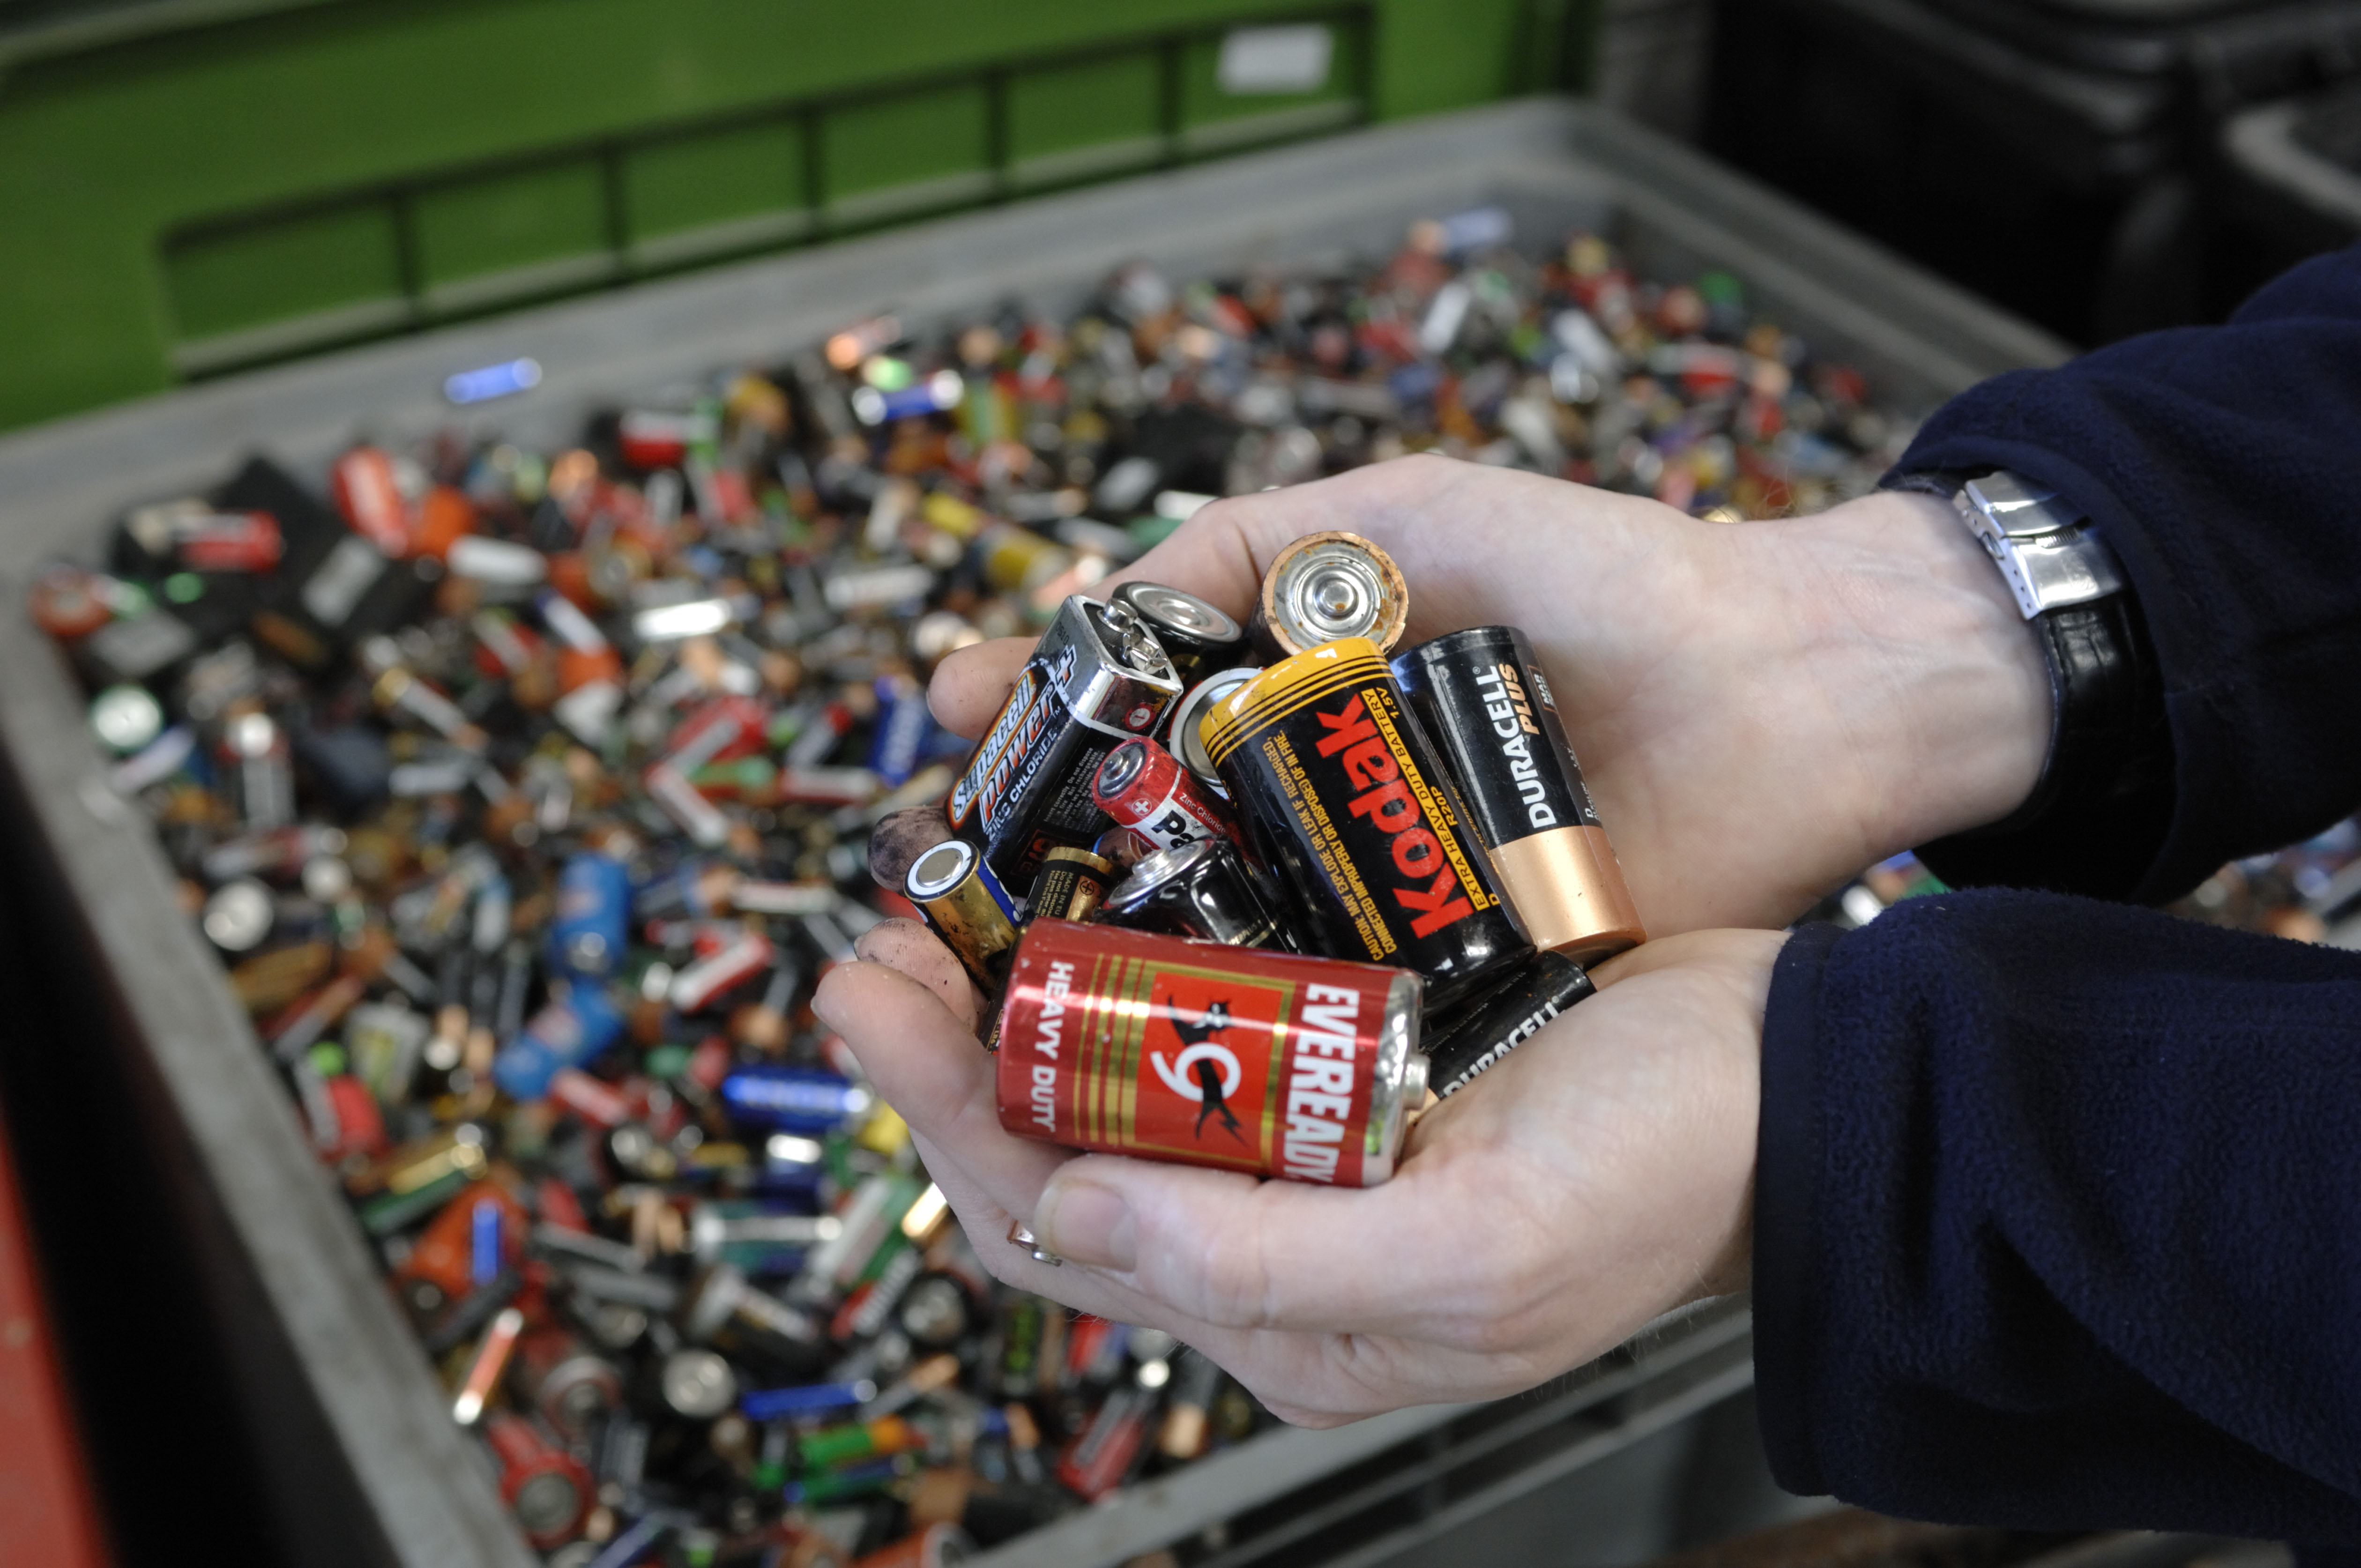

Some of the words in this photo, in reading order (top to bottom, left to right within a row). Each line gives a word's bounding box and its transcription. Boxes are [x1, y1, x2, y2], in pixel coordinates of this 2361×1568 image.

[1376, 686, 1400, 719] 1.5V
[1499, 663, 1540, 735] PLUS
[1274, 730, 1293, 757] FIRE.
[1364, 691, 1409, 758] BATTERY
[953, 674, 1031, 820] Supacell
[1079, 747, 1094, 767] dispose
[1285, 753, 1299, 767] IN
[1476, 665, 1557, 829] DURACELL
[986, 802, 1011, 842] ZINC
[1009, 728, 1058, 803] CHLORIDE
[1262, 736, 1299, 799] RECHARGED,
[1290, 766, 1305, 780] OF
[1402, 762, 1431, 800] DUTY
[1179, 792, 1196, 810] Zinc
[1197, 807, 1226, 833] Chloride
[1292, 800, 1305, 810] IF
[1297, 808, 1318, 836] LEAK
[1298, 778, 1330, 826] DISPOSED
[1315, 693, 1474, 939] Kodak
[1431, 786, 1458, 826] R20P
[1585, 808, 1594, 817] D
[1311, 833, 1326, 851] OR
[1321, 823, 1338, 841] OR
[1425, 804, 1459, 852] HEAVY
[1054, 870, 1061, 880] Ne
[1059, 871, 1067, 881] Do
[1062, 872, 1074, 893] MADE
[1318, 848, 1349, 895] EXPLODE
[1329, 840, 1369, 900] IMPROPERLY
[1454, 857, 1487, 906] EXTRA
[1055, 905, 1063, 915] EU
[1060, 894, 1066, 904] IN
[1341, 893, 1361, 917] MAY
[1489, 894, 1501, 907] D
[1355, 914, 1384, 961] CAUTION:
[1360, 897, 1397, 954] CONNECTED
[1034, 961, 1075, 1060] HEAVY
[1031, 1064, 1056, 1133] DUTY
[1283, 983, 1359, 1183] EVEREADY
